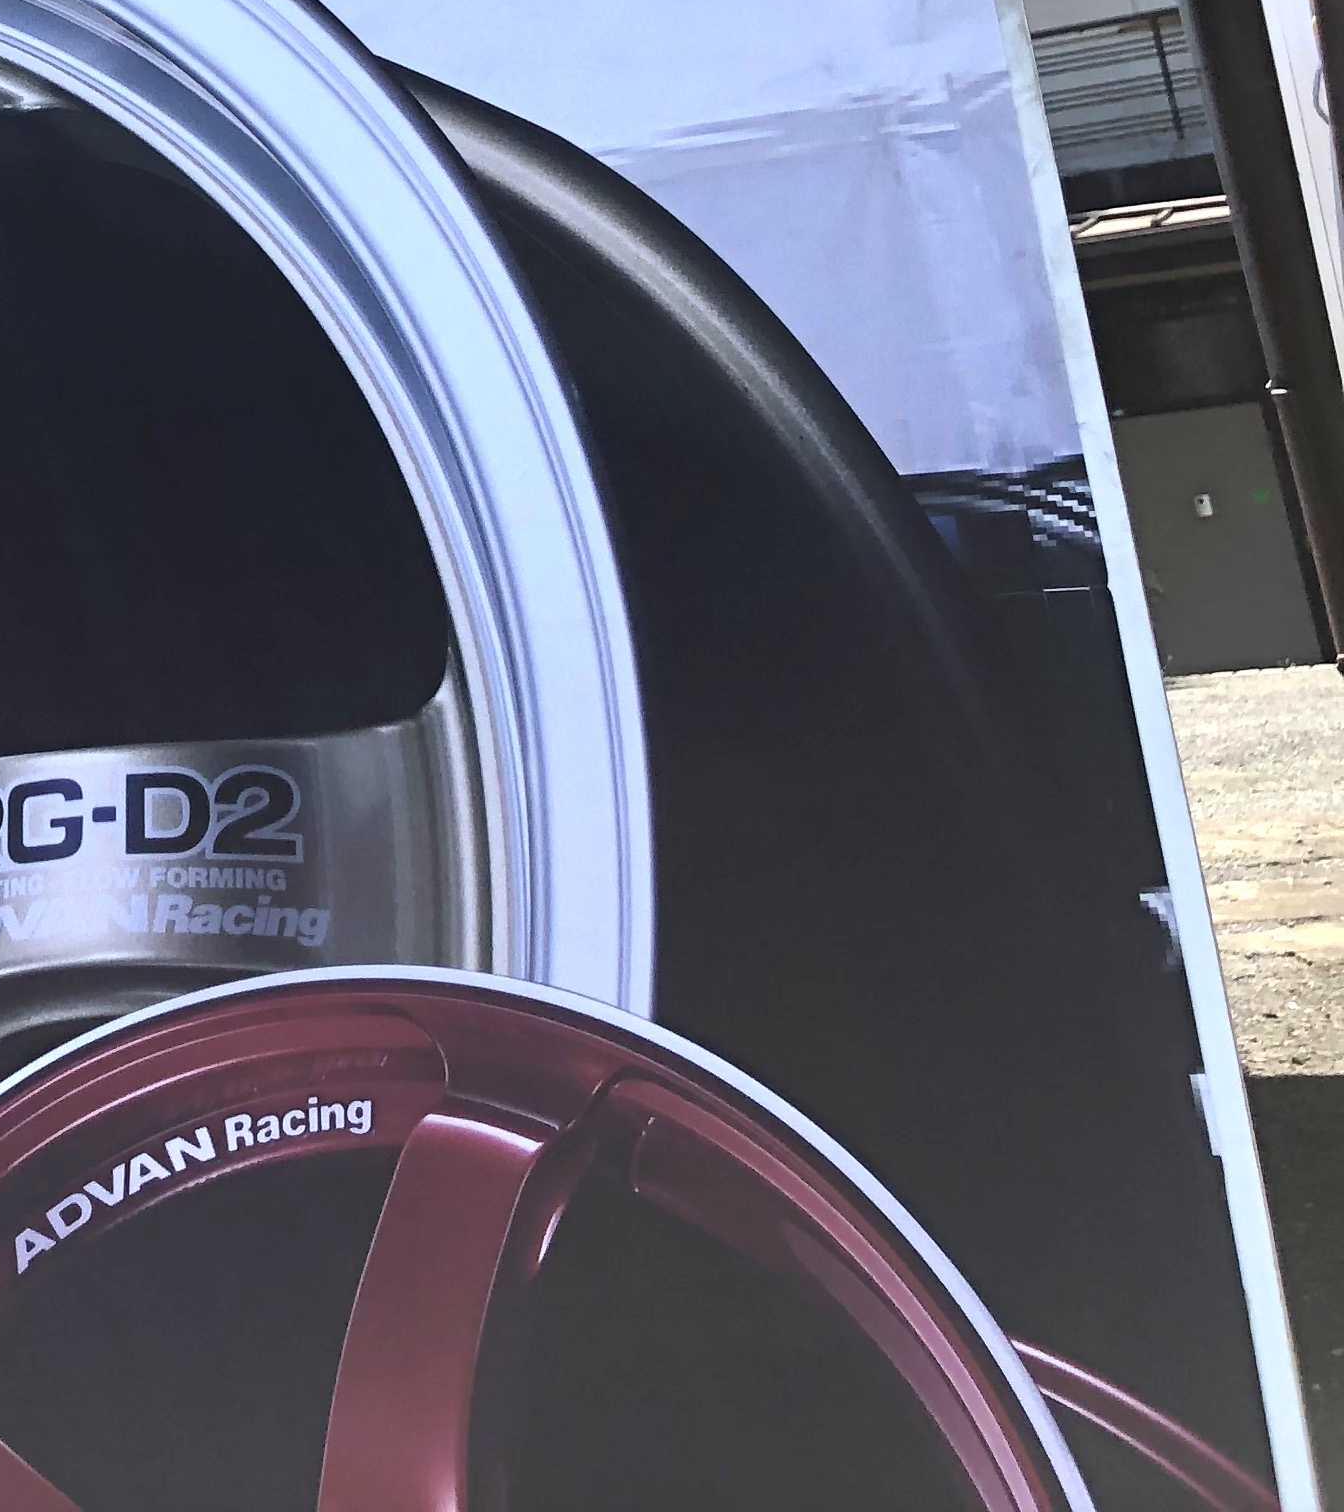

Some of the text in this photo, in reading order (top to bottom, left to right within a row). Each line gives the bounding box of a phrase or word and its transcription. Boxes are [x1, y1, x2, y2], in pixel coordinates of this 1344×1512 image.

[149, 866, 288, 892] FORMING
[153, 894, 331, 948] Racing
[13, 1094, 375, 1276] ADVAN Racing
